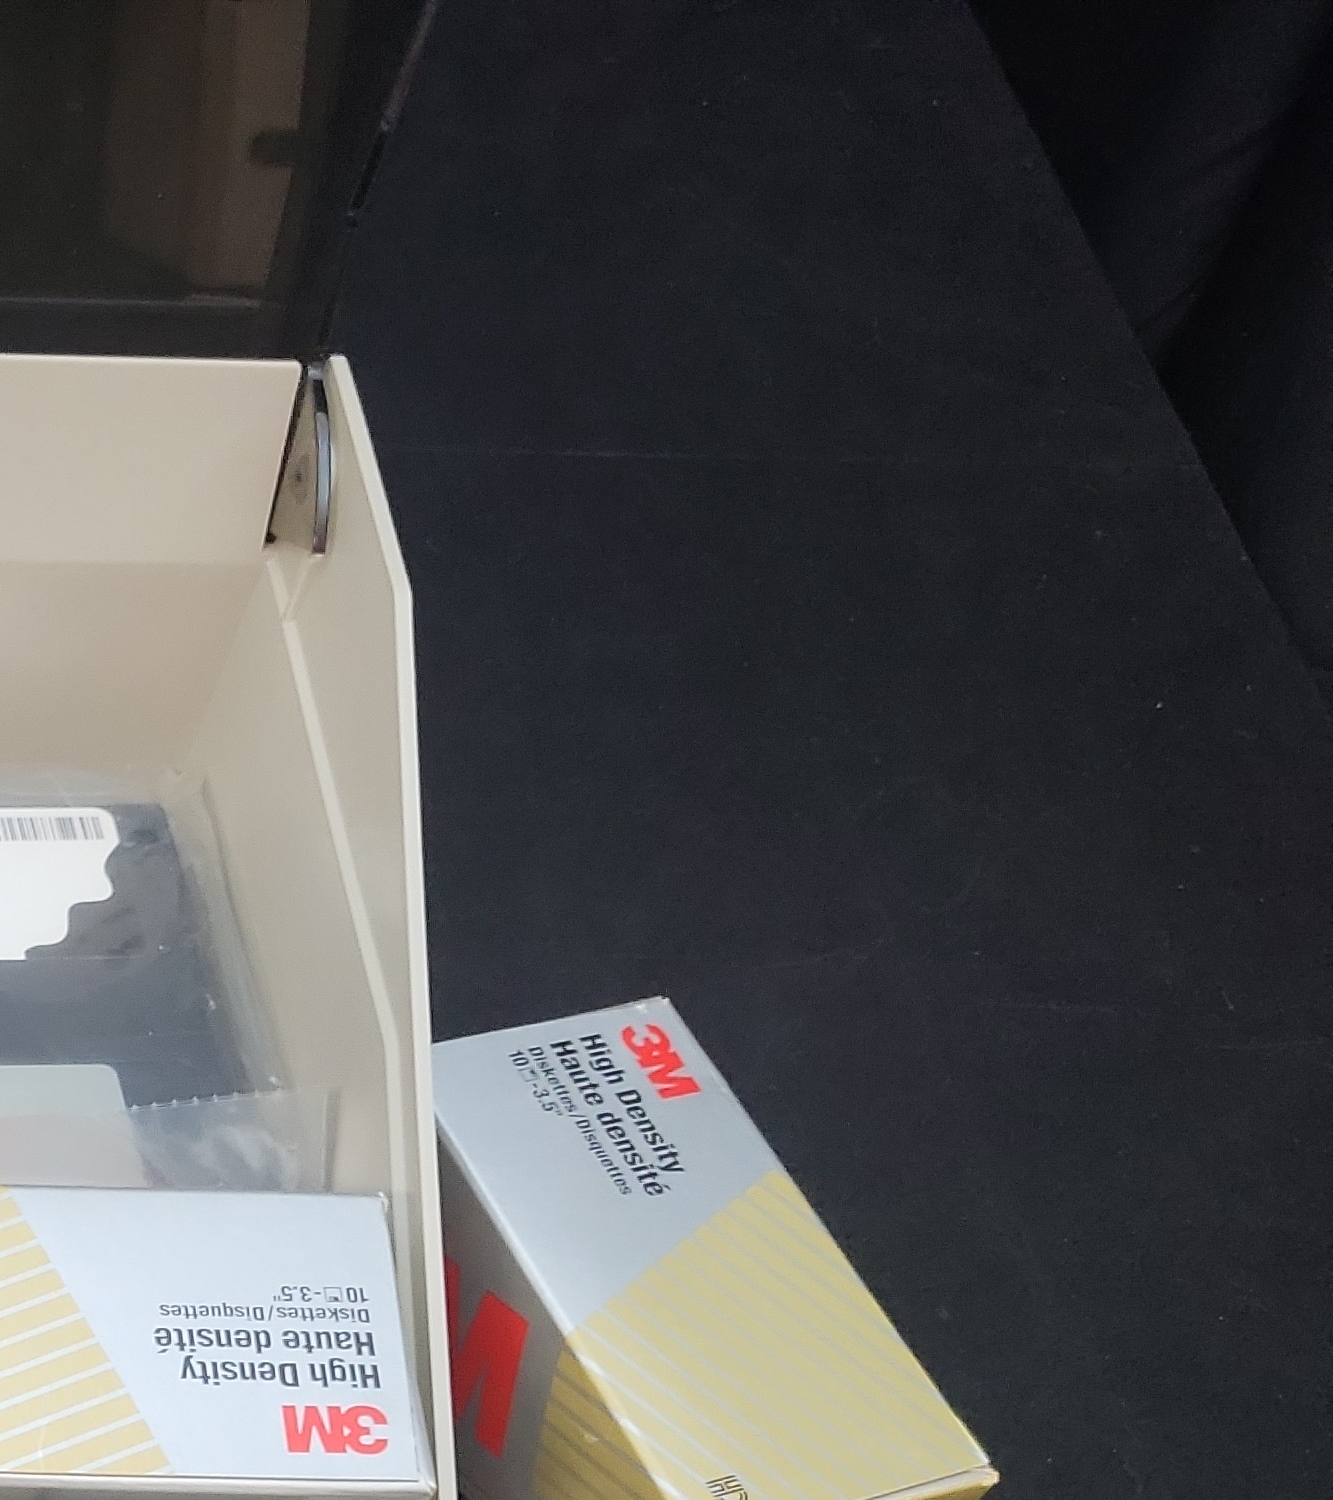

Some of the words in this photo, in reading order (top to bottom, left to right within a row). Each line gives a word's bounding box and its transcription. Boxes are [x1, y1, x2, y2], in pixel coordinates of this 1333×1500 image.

[508, 1050, 529, 1066] 10
[621, 1023, 702, 1100] 3M
[549, 1040, 604, 1106] Haute
[596, 1112, 671, 1196] densité
[579, 1033, 626, 1085] High
[614, 1089, 685, 1173] Density
[346, 1287, 370, 1302] 10
[153, 1327, 272, 1354] densité
[282, 1331, 376, 1356] Haute
[180, 1355, 300, 1387] Density
[309, 1358, 381, 1388] High
[281, 1404, 389, 1455] 3M
